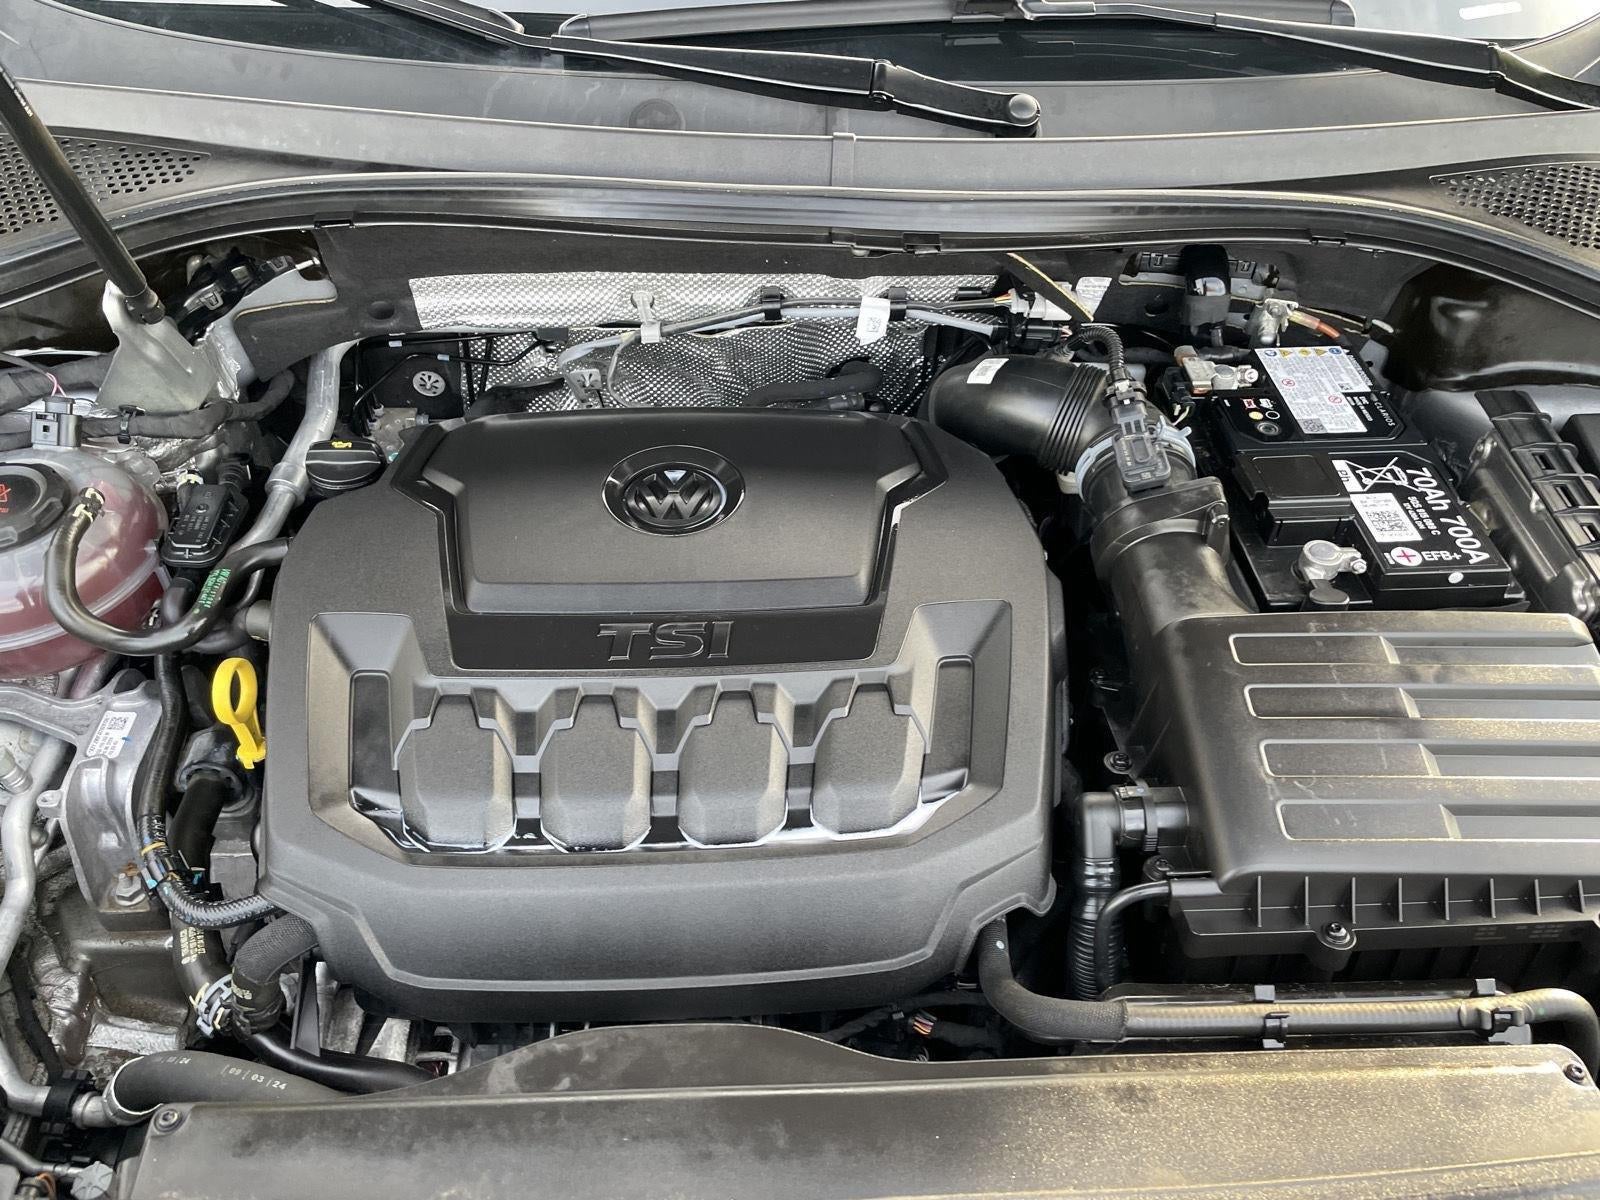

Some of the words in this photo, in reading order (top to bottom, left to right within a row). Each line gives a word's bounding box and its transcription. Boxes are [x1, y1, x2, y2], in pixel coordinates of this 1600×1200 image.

[1374, 402, 1395, 426] CLARIOS
[1406, 467, 1451, 510] 70Ah
[1440, 515, 1490, 564] 700A
[1421, 550, 1461, 561] EFB+
[597, 621, 734, 661] TSI
[272, 1080, 287, 1090] 24
